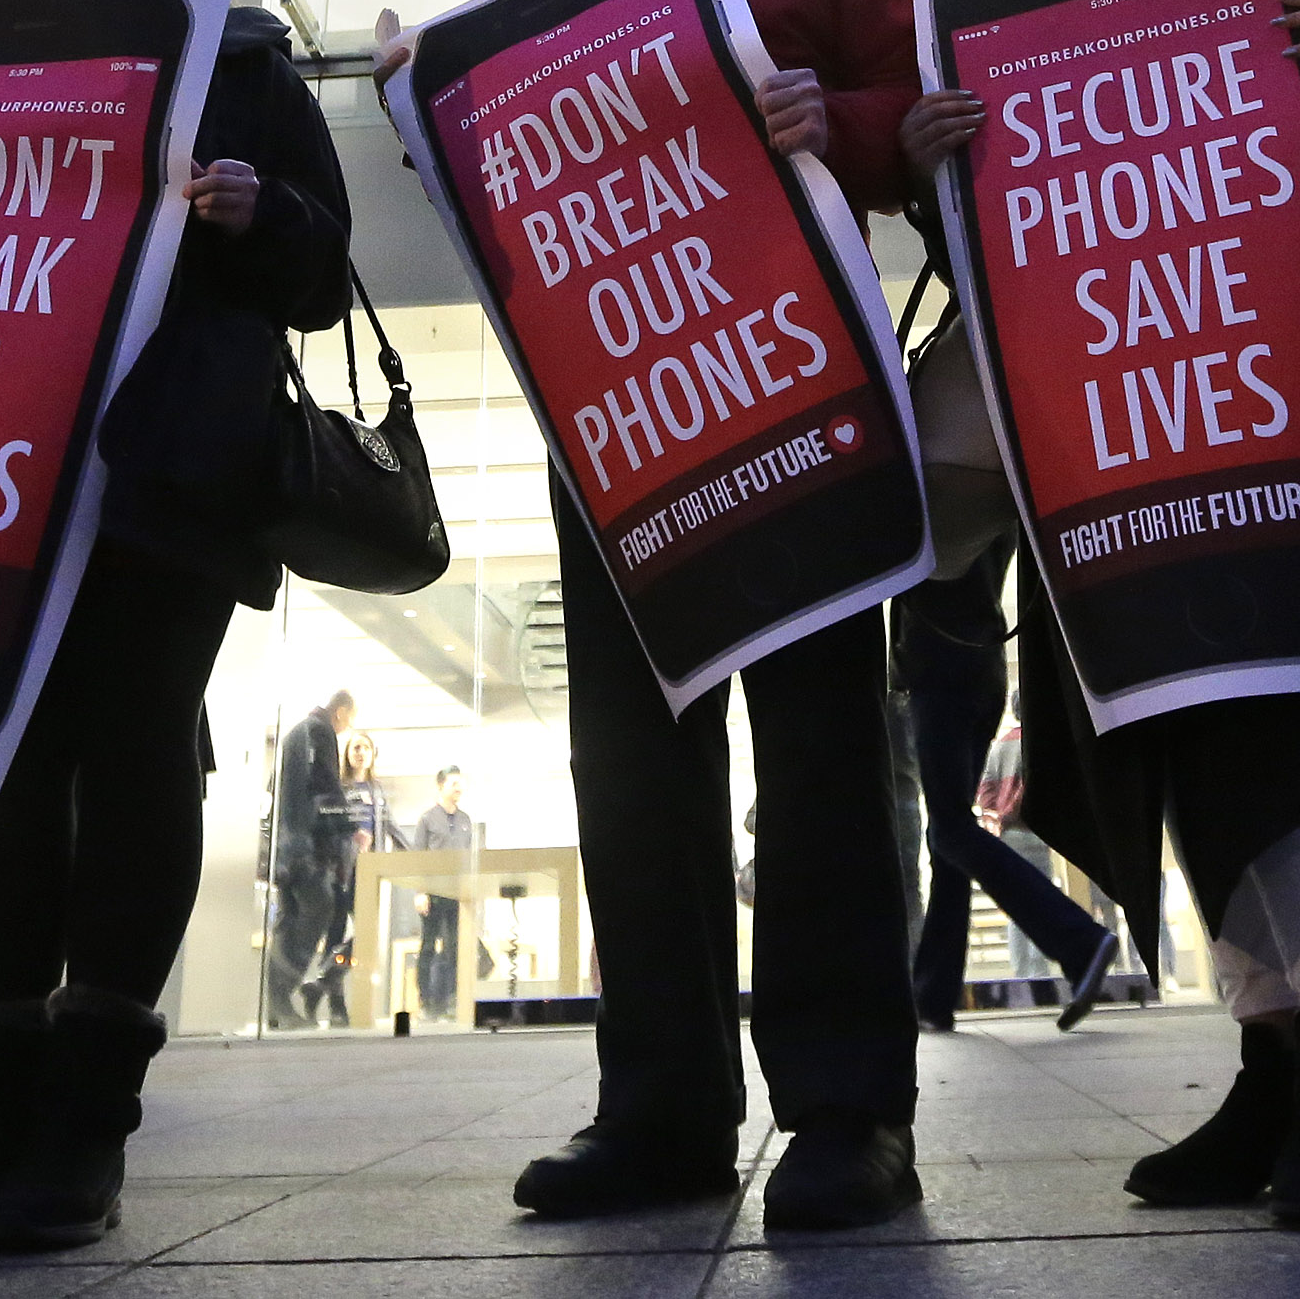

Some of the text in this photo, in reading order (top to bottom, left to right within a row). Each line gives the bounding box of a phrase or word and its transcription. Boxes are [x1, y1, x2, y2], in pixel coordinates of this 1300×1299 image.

[28, 67, 44, 77] PM
[110, 62, 133, 72] 100%
[460, 5, 673, 131] DONTBREAKOURPHONES.ORG
[535, 32, 555, 46] 5:30
[556, 24, 571, 37] PM
[988, 1, 1256, 79] DONTBREAKOURPHONES.ORG
[480, 31, 691, 212] #DON'T
[1000, 39, 1264, 168] SECURE
[521, 126, 729, 290] BREAK
[1004, 126, 1295, 268] PHONES
[587, 237, 734, 359] OUR
[1075, 237, 1257, 356] SAVE
[574, 291, 827, 494] PHONES
[1084, 343, 1289, 471] LIVES
[618, 509, 673, 571] FIGHT
[732, 428, 832, 501] FUTURE
[1059, 514, 1123, 569] FIGHT
